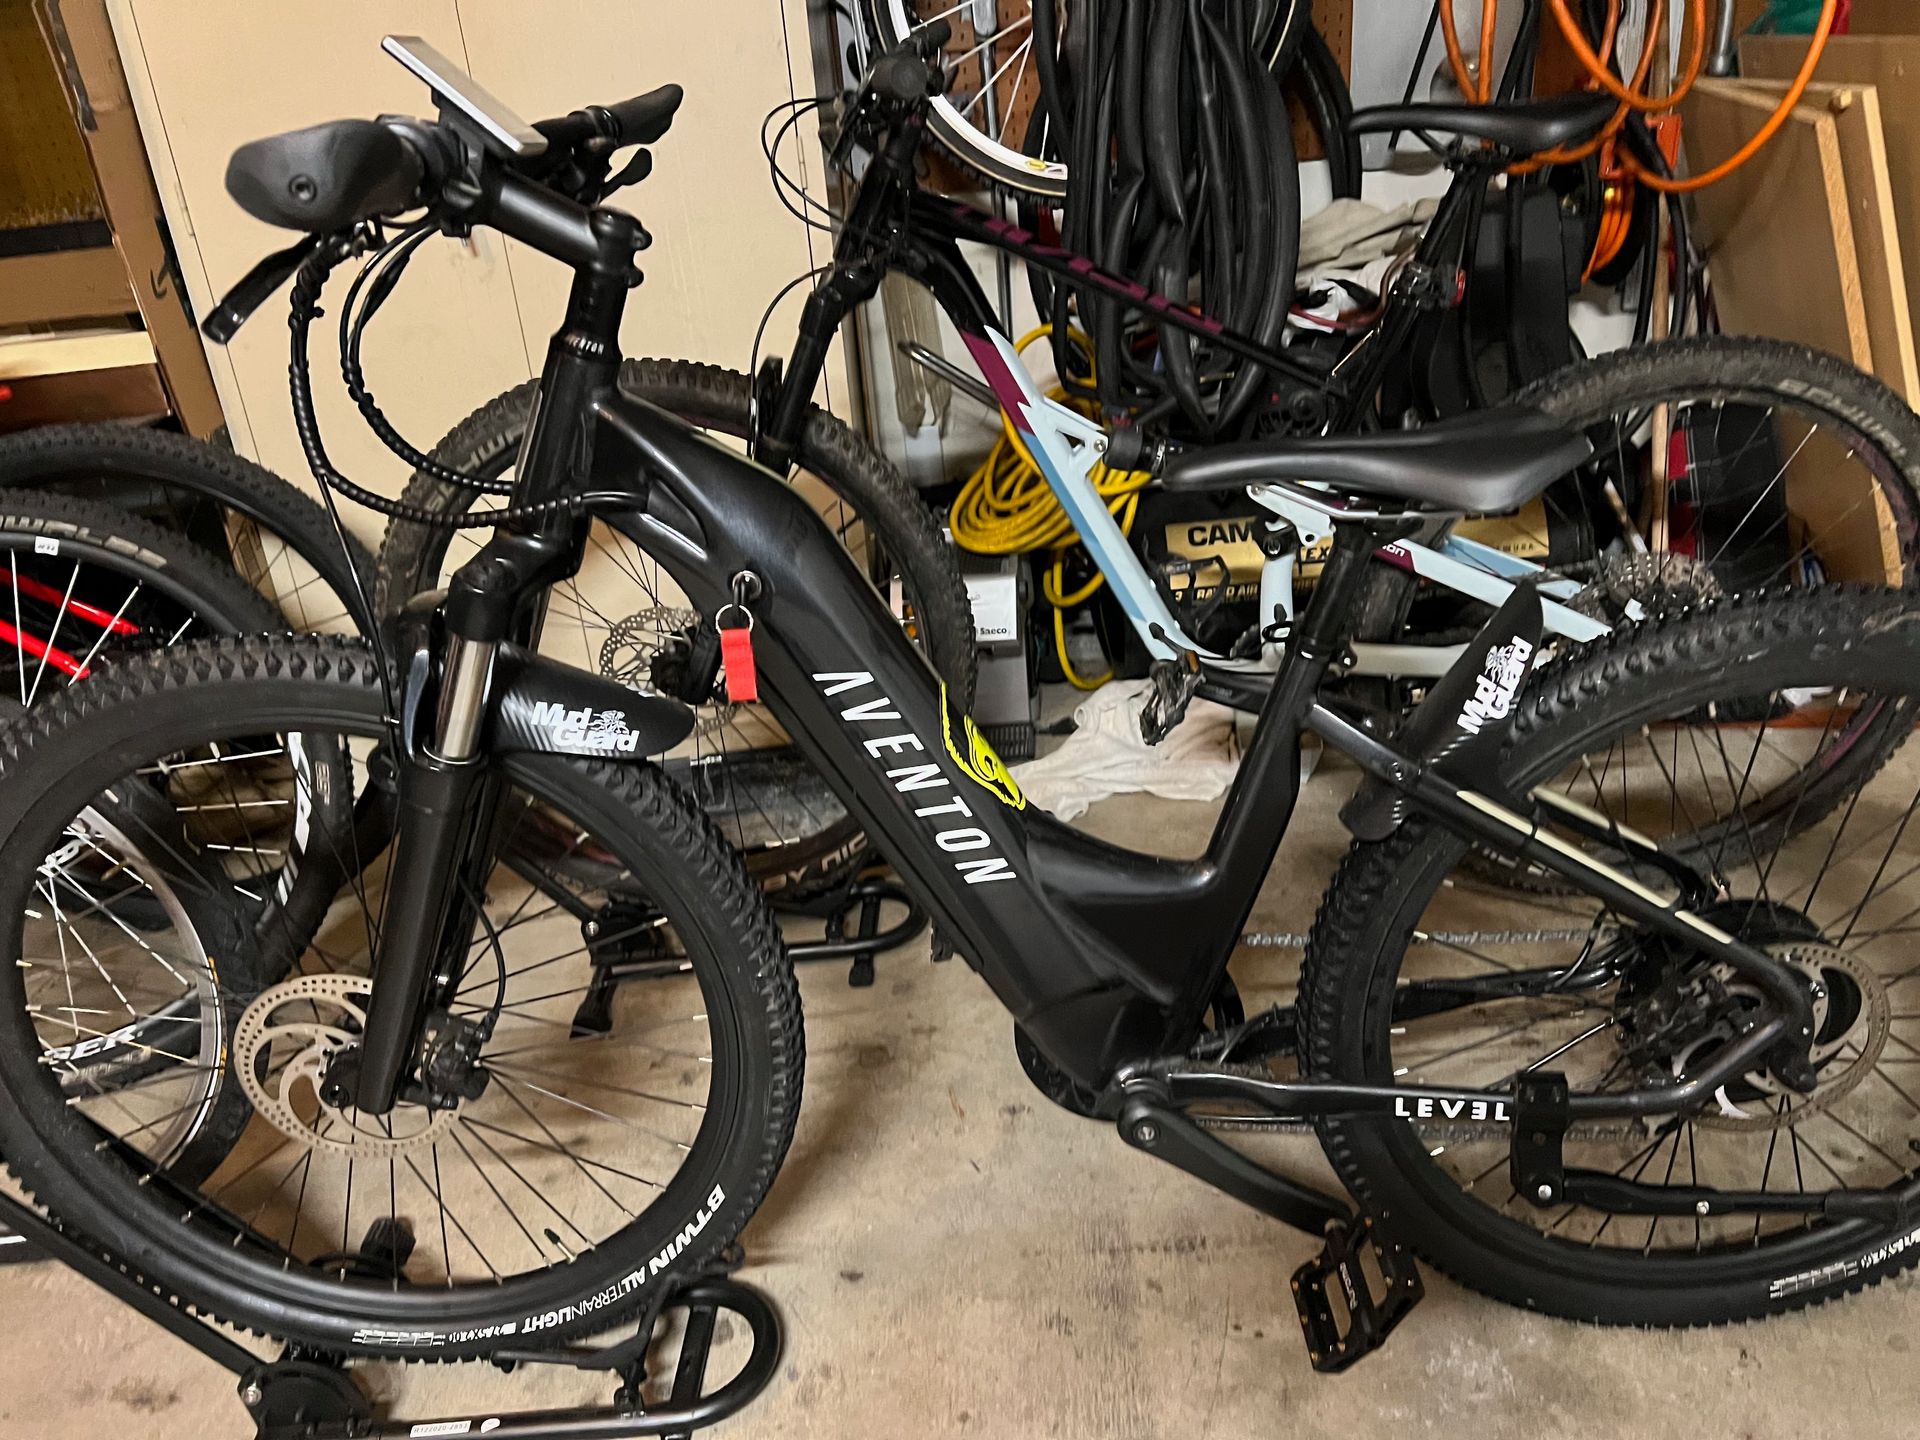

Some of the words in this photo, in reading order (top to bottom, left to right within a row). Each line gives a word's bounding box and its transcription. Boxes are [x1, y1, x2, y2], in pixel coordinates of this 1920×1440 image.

[980, 627, 1007, 636] Saeco
[1484, 635, 1533, 720] Guard
[531, 701, 592, 730] Mud
[1456, 674, 1499, 735] Mud
[552, 729, 640, 752] Guard
[812, 671, 1017, 885] AVENTON
[1395, 1097, 1510, 1121] LEVEL
